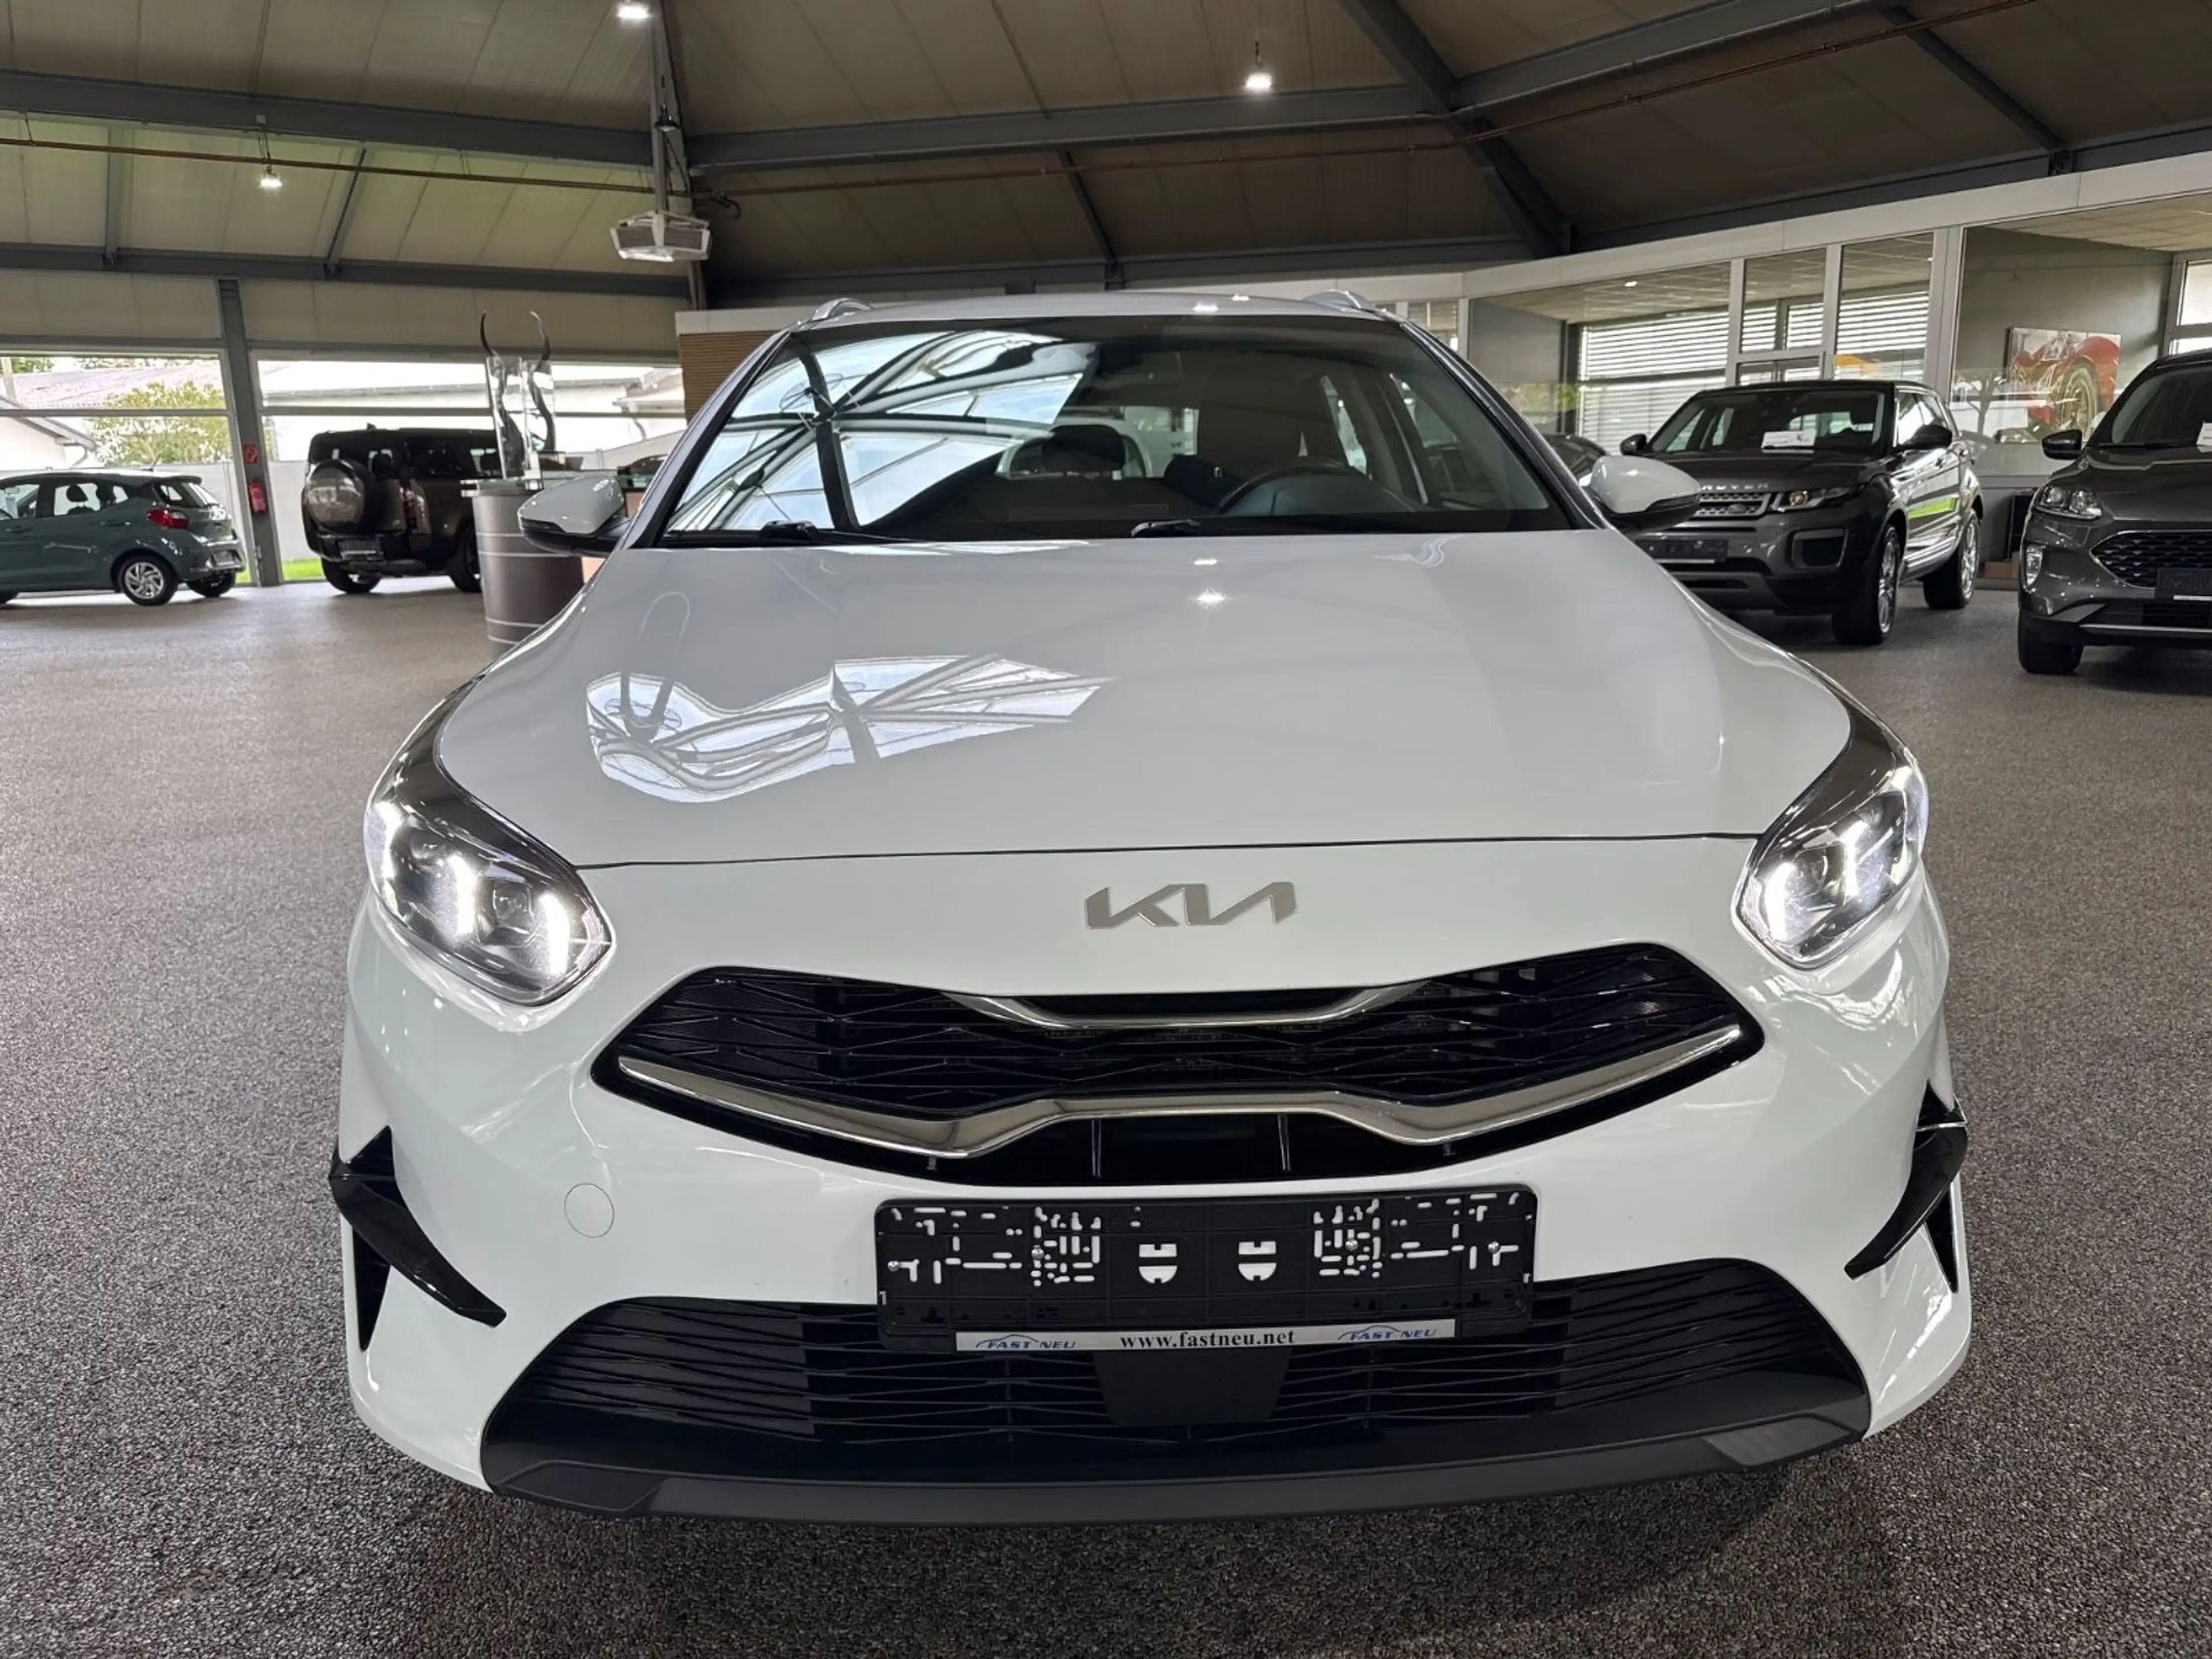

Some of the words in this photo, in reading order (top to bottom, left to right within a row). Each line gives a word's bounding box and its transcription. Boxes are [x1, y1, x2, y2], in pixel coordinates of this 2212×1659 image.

[1085, 881, 1297, 928] KIA
[1120, 1331, 1294, 1348] www.fastneu.net
[1350, 1331, 1393, 1340] FAST
[1402, 1329, 1437, 1338] NEU
